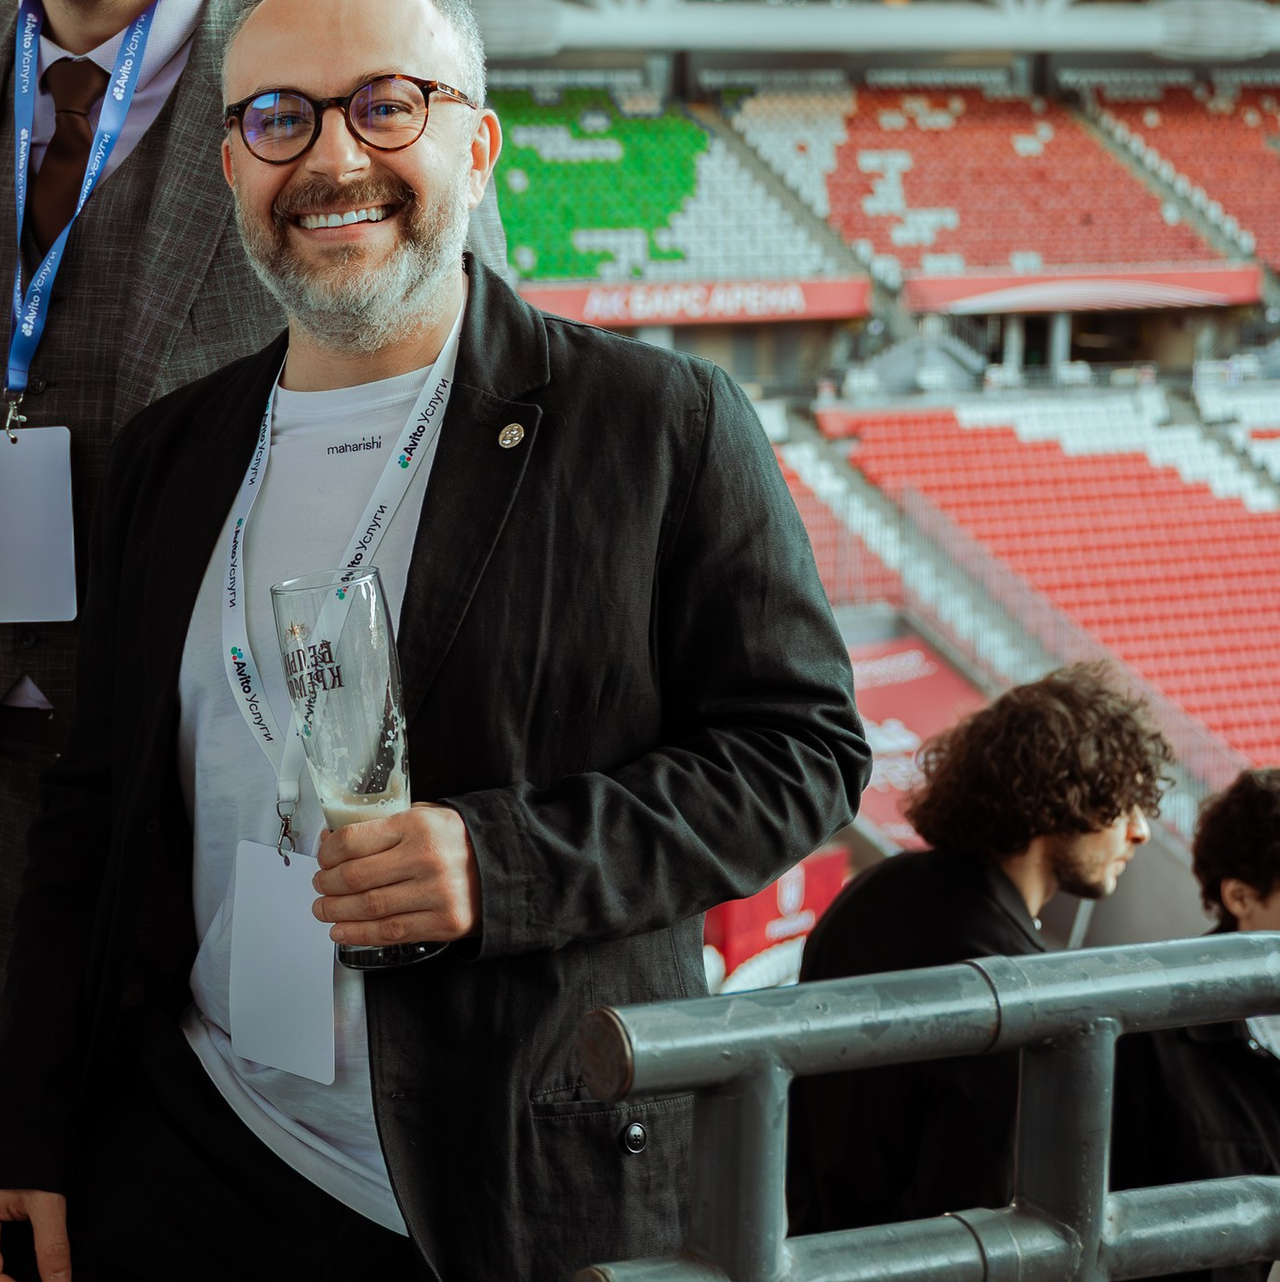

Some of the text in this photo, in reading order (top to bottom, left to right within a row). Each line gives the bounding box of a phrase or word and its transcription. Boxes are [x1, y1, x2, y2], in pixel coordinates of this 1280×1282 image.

[20, 21, 38, 95] Avito Услуги
[116, 14, 147, 90] Avito Услуги
[18, 139, 29, 169] Avito
[89, 133, 111, 179] Услуги
[24, 251, 58, 325] Avito Услуги
[707, 283, 807, 317] АРЕНА
[327, 436, 382, 455] maharishi
[403, 377, 451, 457] Avito Услуги
[248, 441, 268, 487] Услуги
[355, 504, 389, 552] Услуги
[226, 528, 242, 608] Avito Услуги
[234, 660, 274, 742] Avito Услуги
